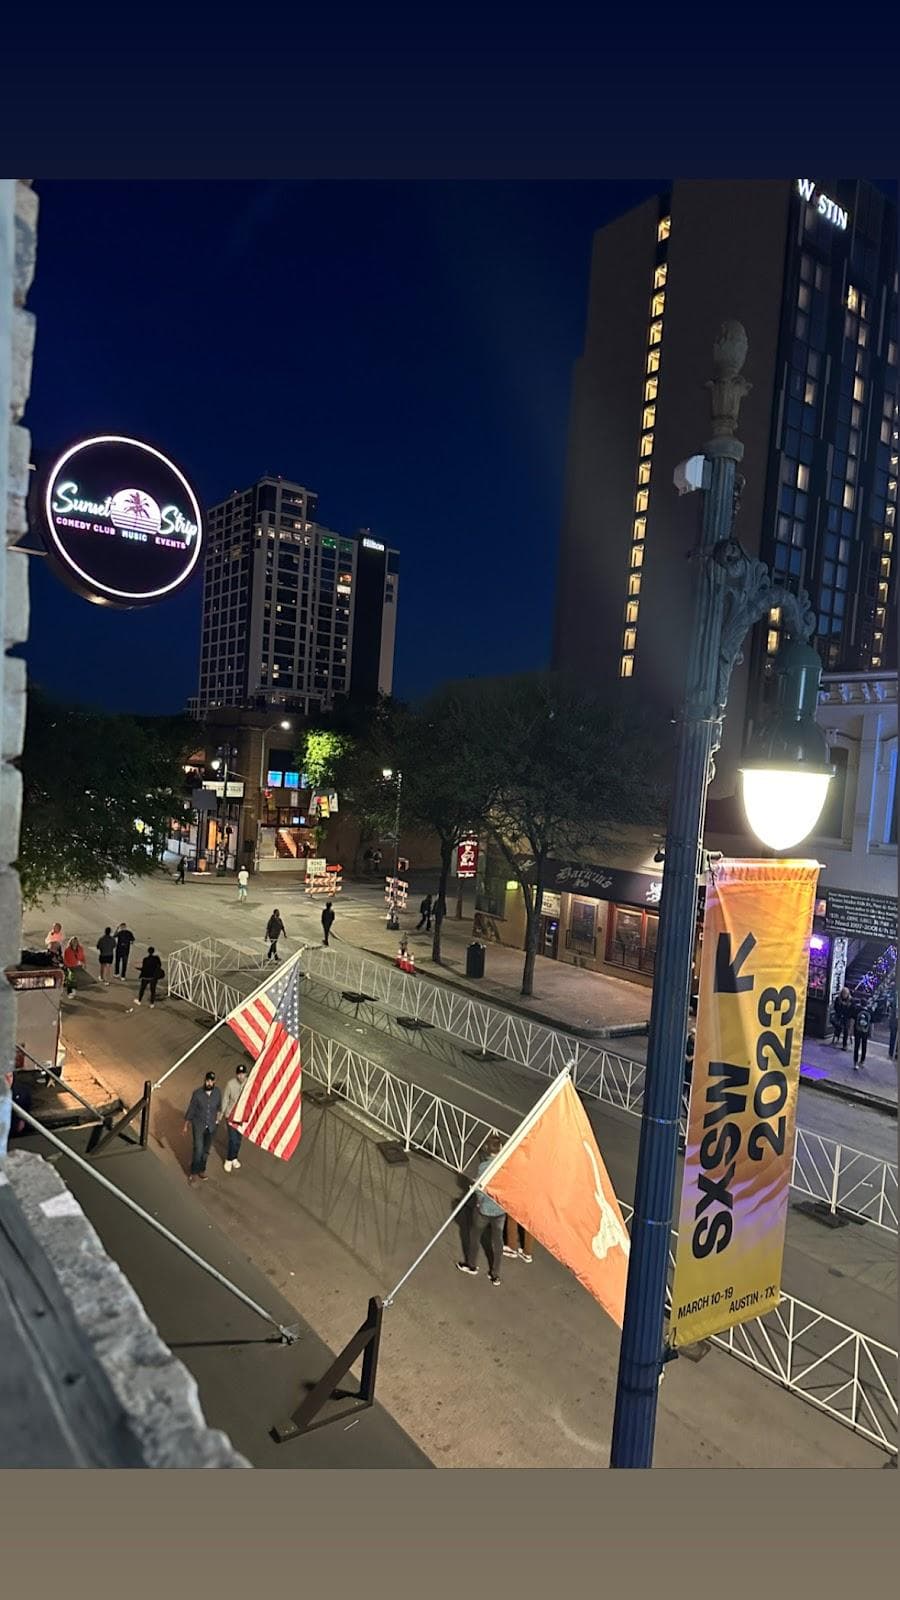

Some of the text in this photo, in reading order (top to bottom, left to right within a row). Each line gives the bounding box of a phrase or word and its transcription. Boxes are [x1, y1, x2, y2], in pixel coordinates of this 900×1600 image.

[798, 179, 848, 230] WSTIN
[53, 482, 198, 545] Sunset Strip
[55, 516, 187, 550] COMEDY CLUB MUSIC EVENTS
[556, 867, 613, 888] Darwin's
[747, 985, 797, 1161] 2023
[692, 1062, 750, 1259] SXSW
[678, 1286, 733, 1319] MARCH 10-19
[728, 1285, 776, 1313] AUSTIN TX
